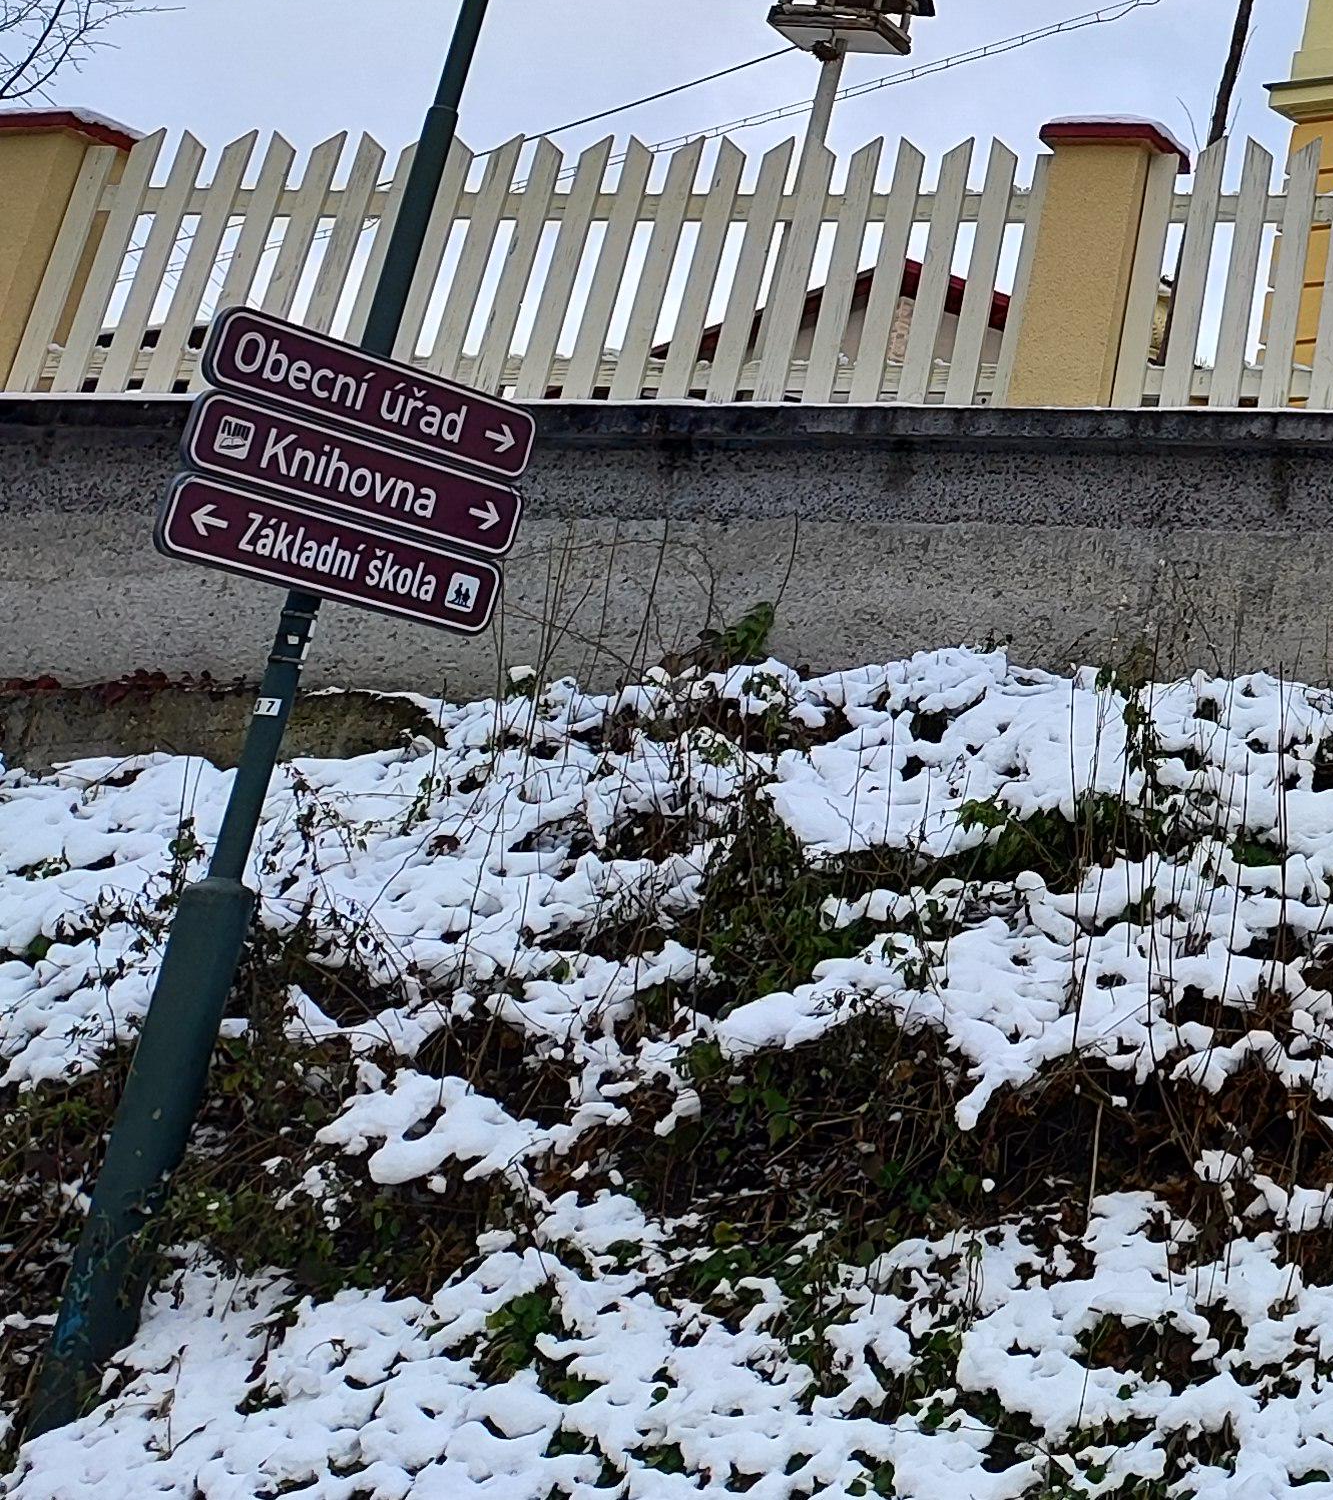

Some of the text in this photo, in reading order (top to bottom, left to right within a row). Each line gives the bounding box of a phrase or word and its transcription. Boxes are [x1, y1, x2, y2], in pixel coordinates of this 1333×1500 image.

[234, 332, 467, 443] Obecní úřad
[260, 428, 437, 518] Knihovna
[238, 512, 436, 601] Základní škola
